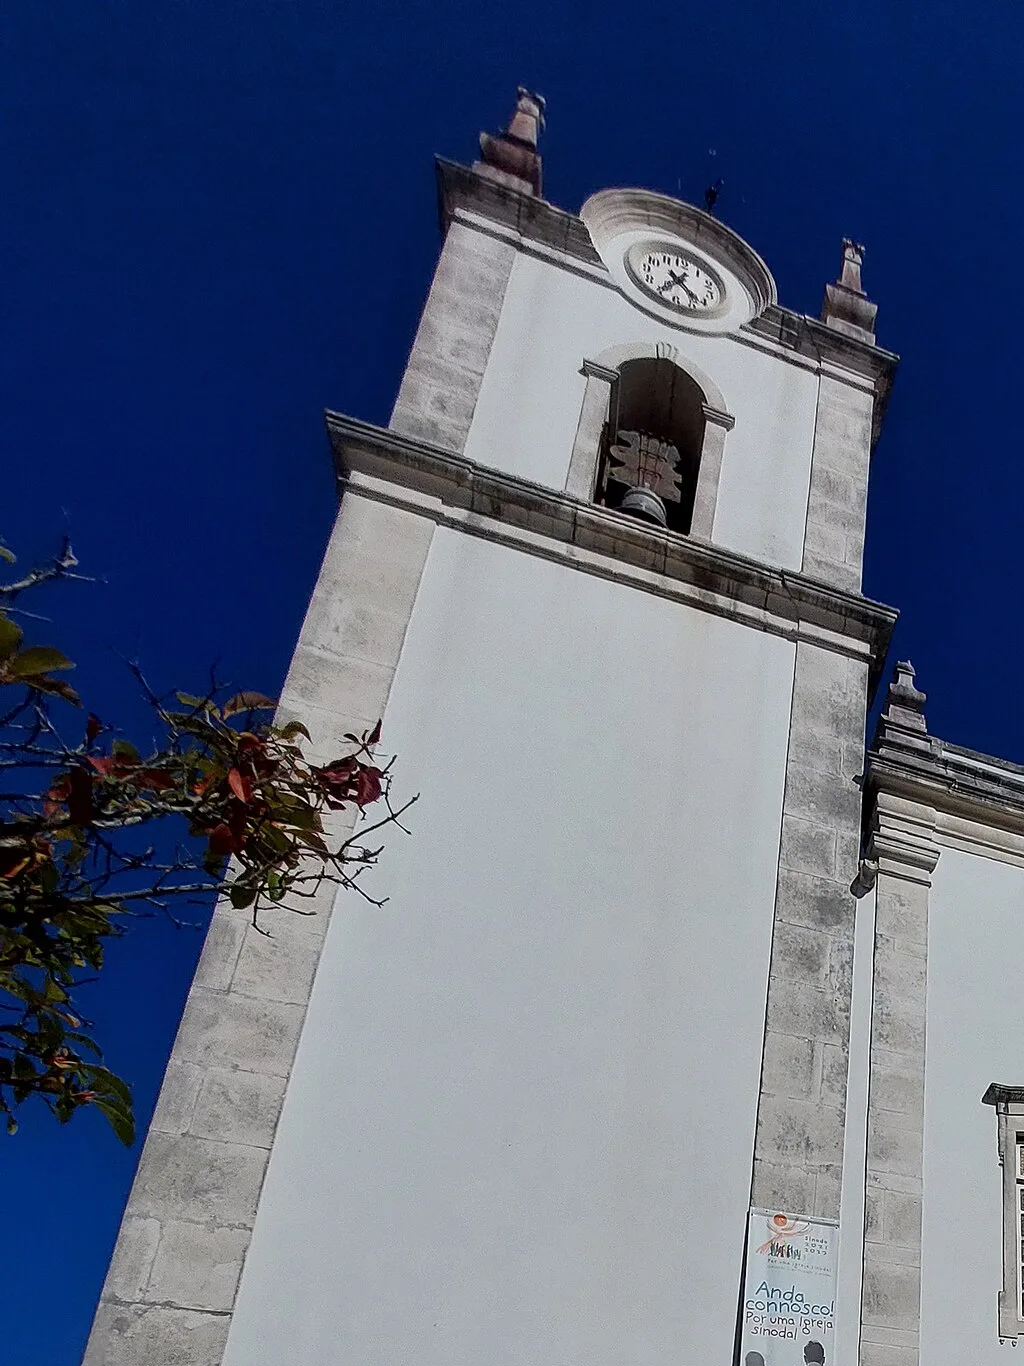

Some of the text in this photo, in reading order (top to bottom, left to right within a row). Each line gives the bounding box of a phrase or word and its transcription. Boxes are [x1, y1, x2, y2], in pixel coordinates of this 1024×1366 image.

[648, 255, 660, 267] 10
[663, 255, 671, 266] 11
[675, 256, 689, 270] 12
[642, 263, 651, 273] 9
[696, 269, 700, 278] 1
[645, 274, 654, 284] 8
[704, 279, 713, 290] 2
[672, 295, 680, 304] 6
[705, 290, 714, 300] 3
[755, 1280, 804, 1303] Anda
[745, 1300, 835, 1317] connosco!
[745, 1311, 833, 1335] Por uma Igreja
[751, 1324, 797, 1340] sinodal
